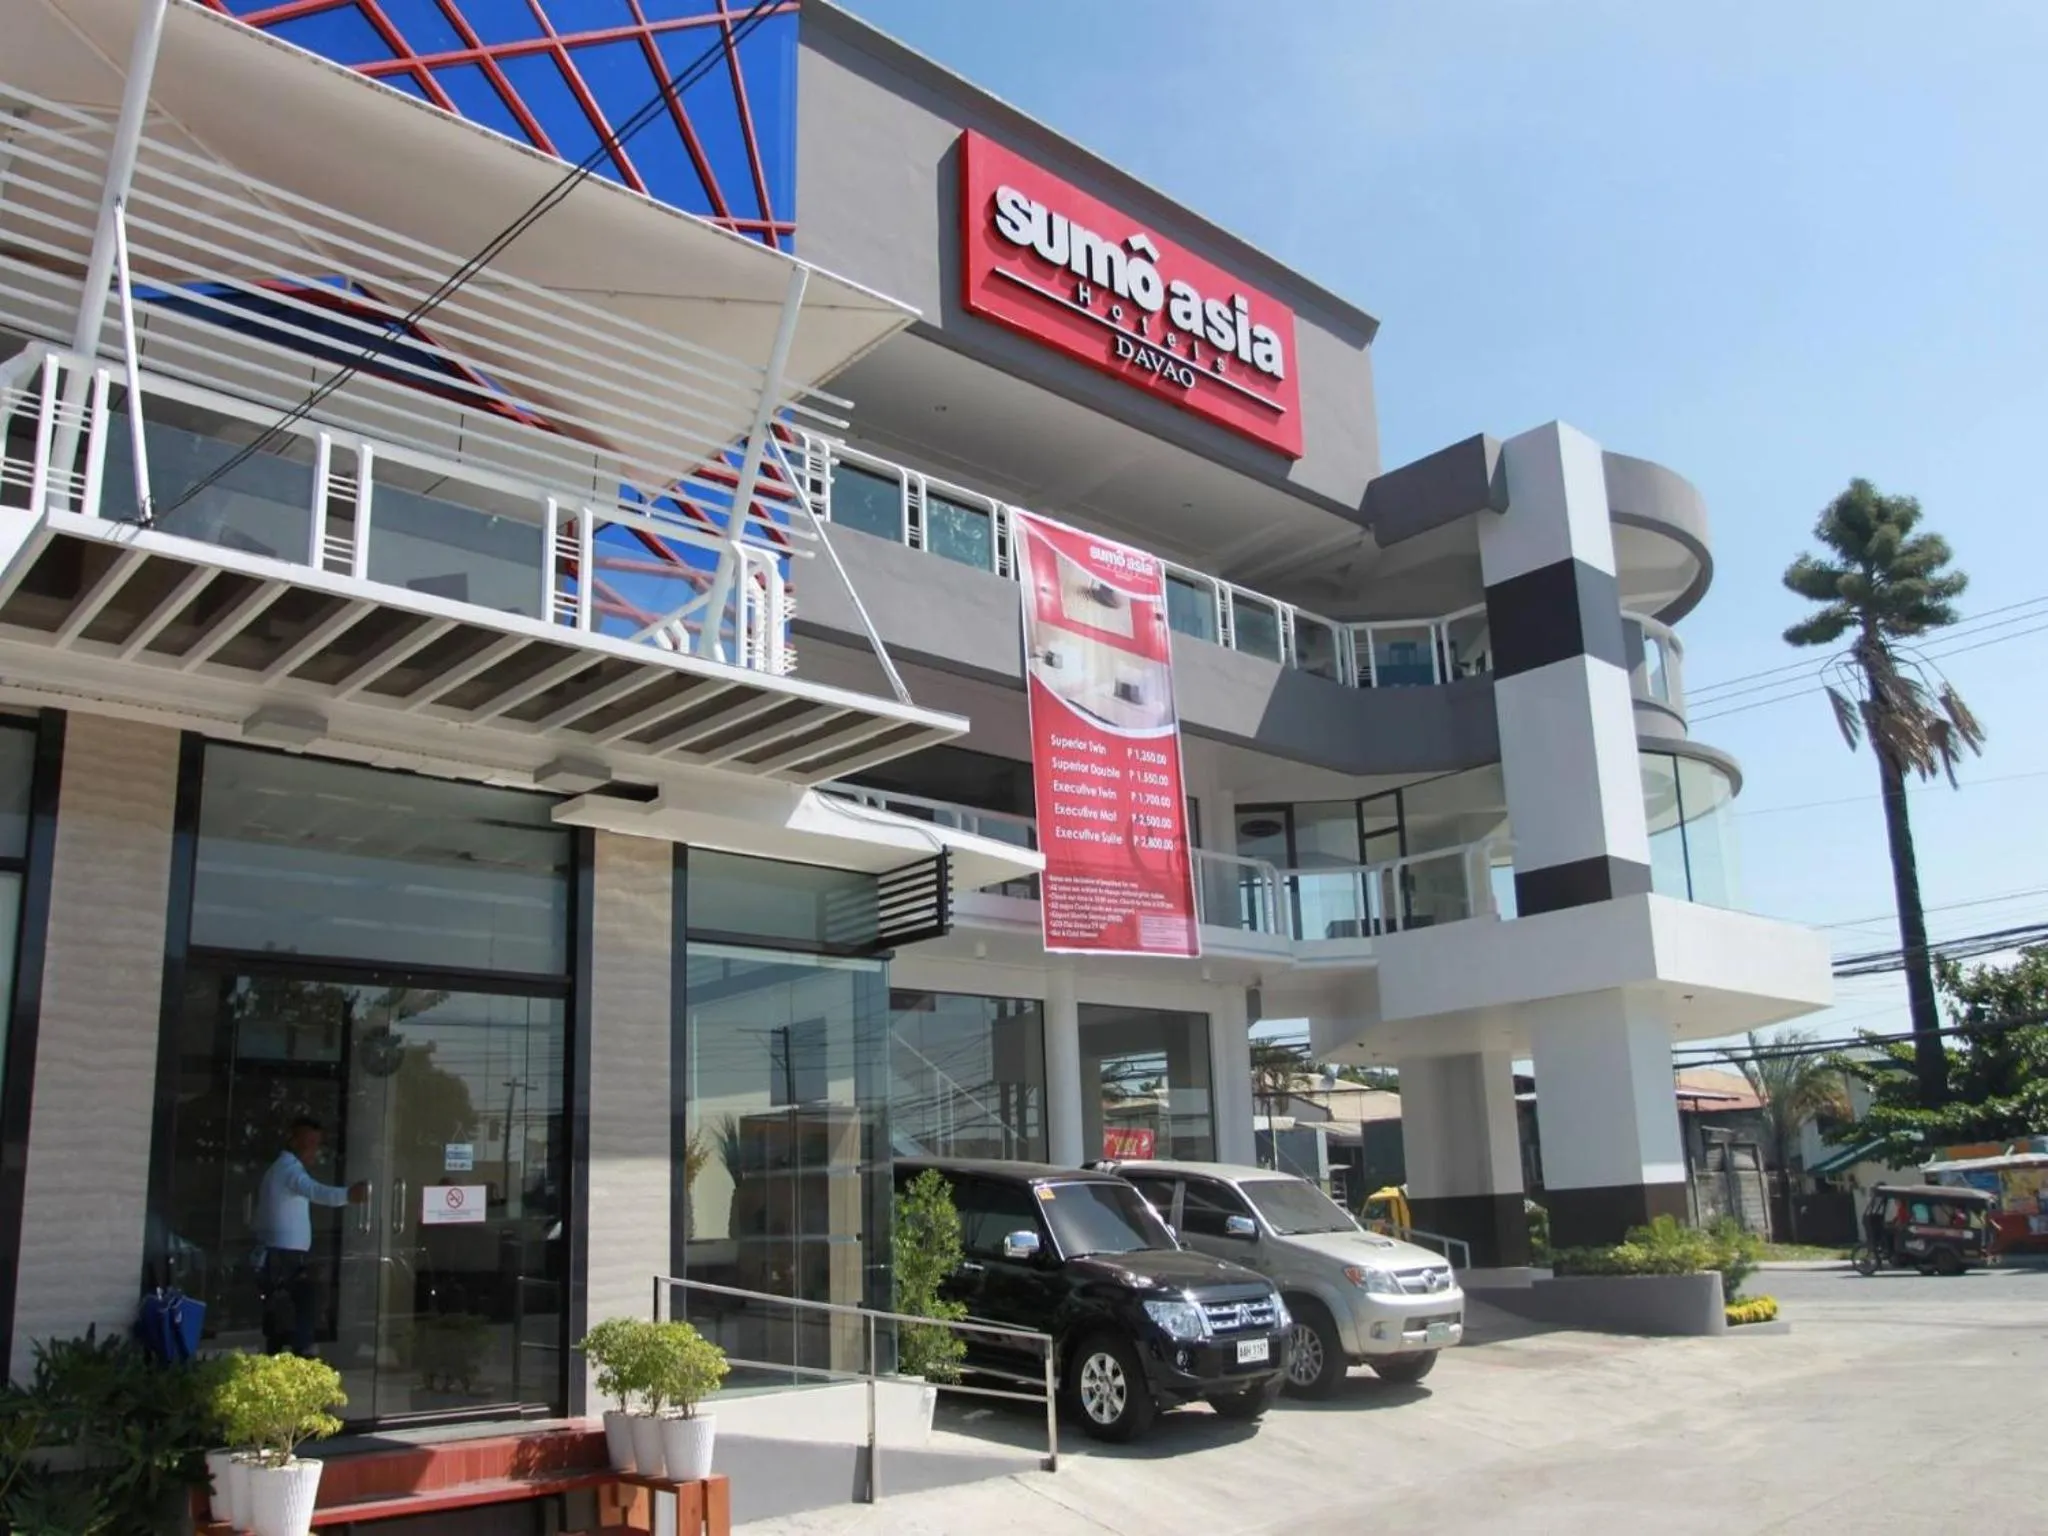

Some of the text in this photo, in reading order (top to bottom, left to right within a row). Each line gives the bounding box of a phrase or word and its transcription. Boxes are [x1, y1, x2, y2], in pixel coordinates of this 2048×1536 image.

[994, 184, 1285, 382] sumô asia
[1116, 335, 1197, 390] DAVAO
[1050, 734, 1088, 751] Superior
[1089, 740, 1107, 755] Twin
[1051, 756, 1089, 773] Superior
[1090, 763, 1121, 779] Double
[1053, 779, 1098, 797] Executive
[1098, 786, 1117, 800] Twin
[1054, 802, 1099, 820] Executive
[1055, 826, 1100, 842] Executive
[1101, 831, 1123, 845] Suite
